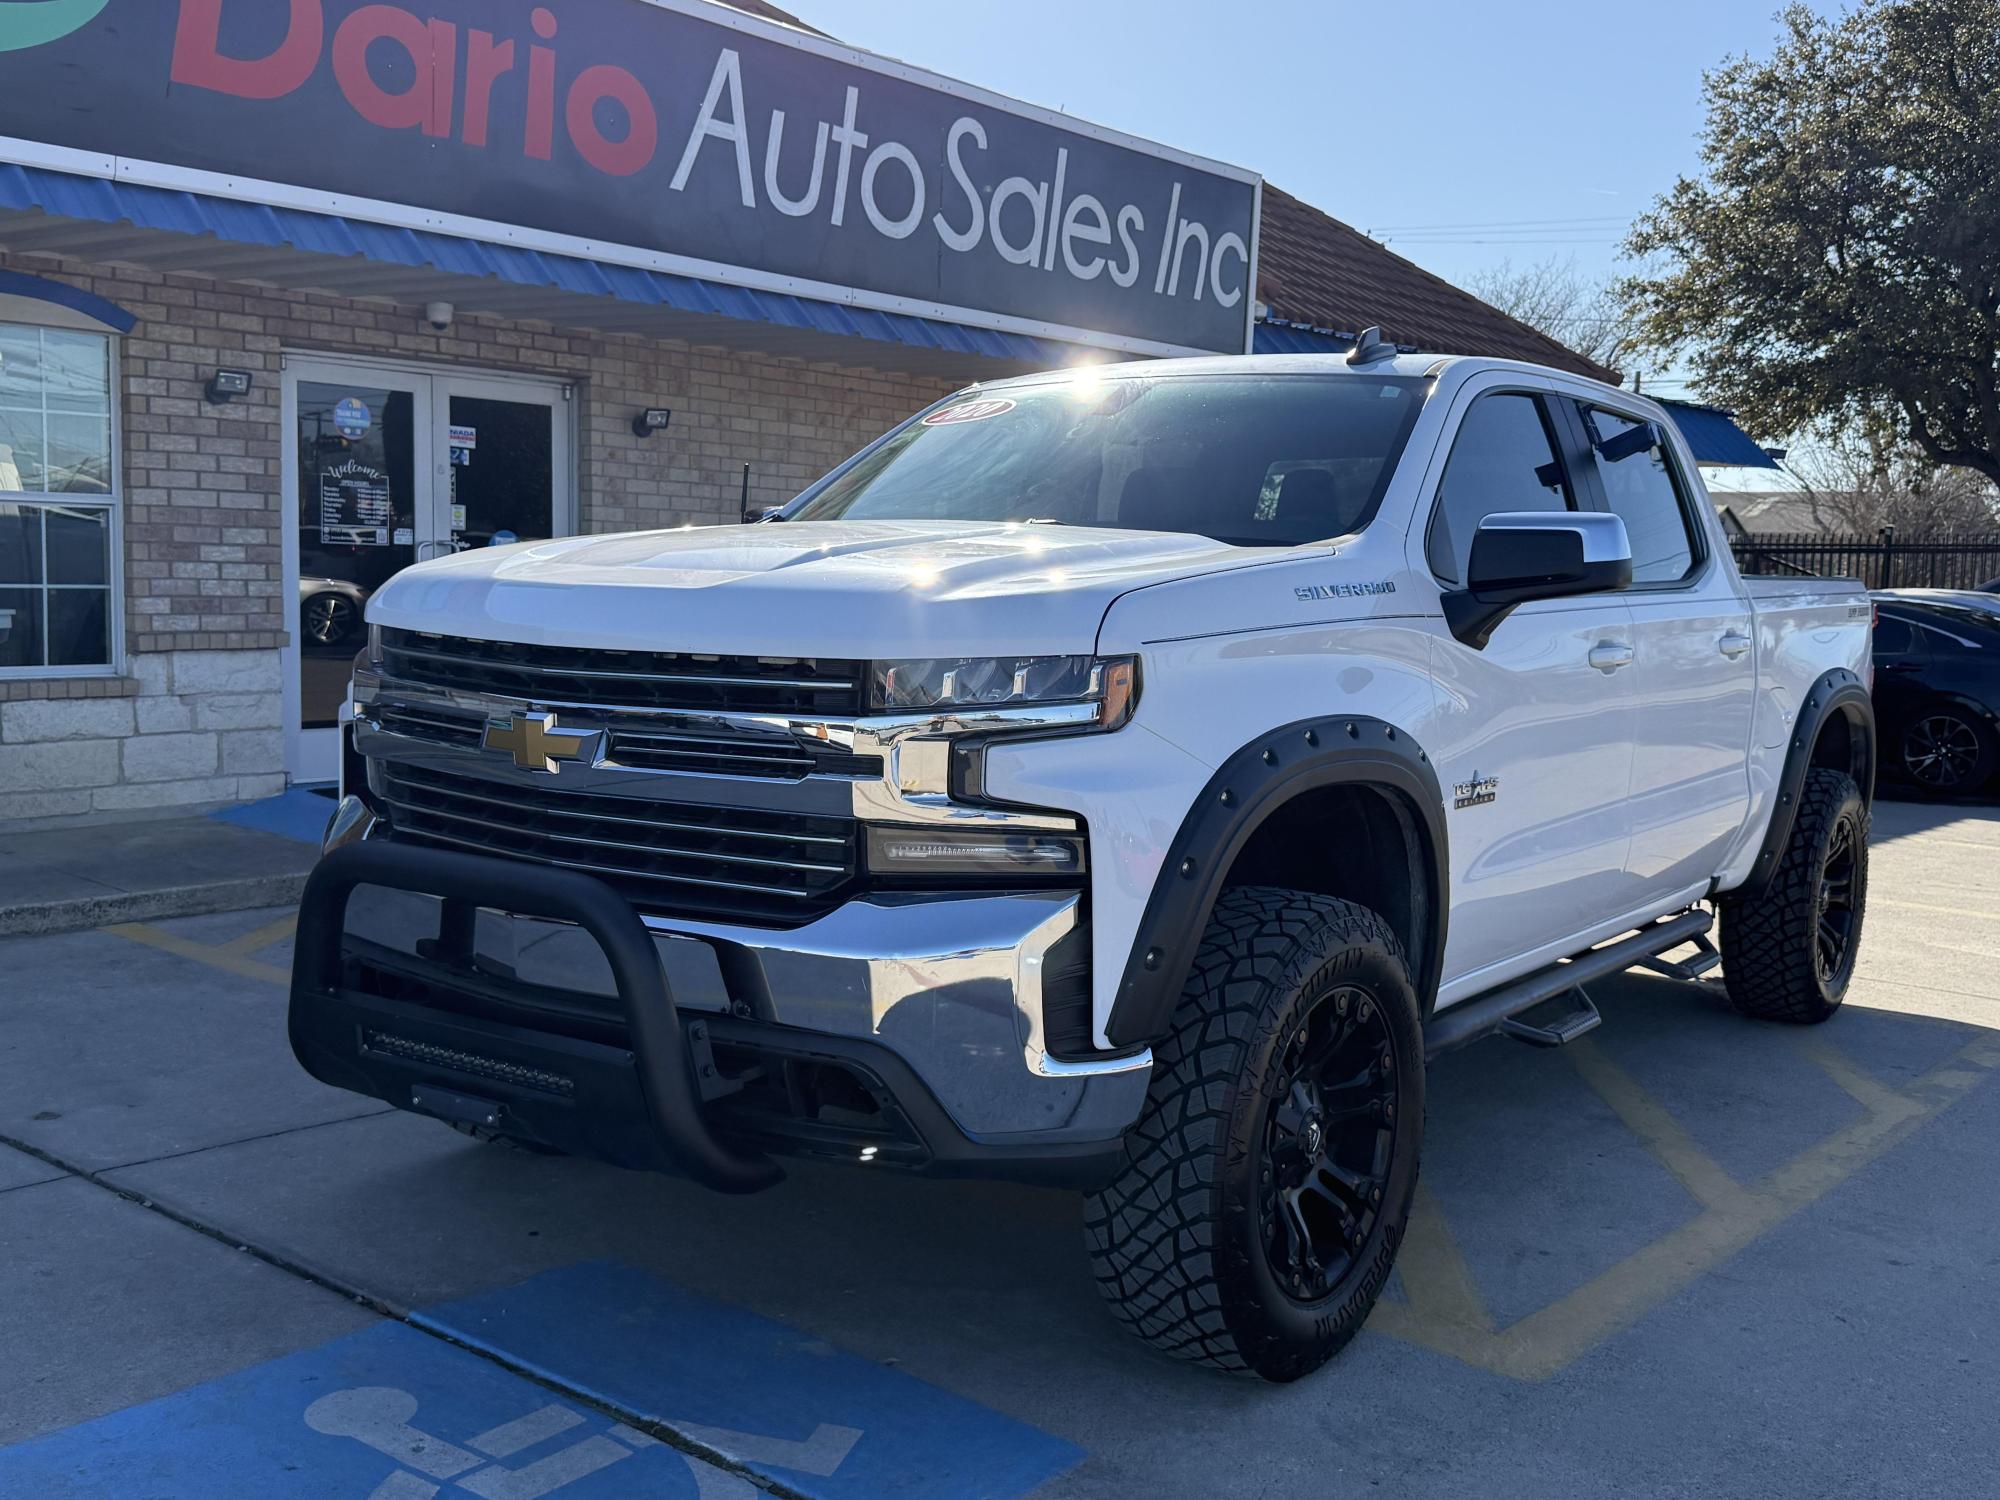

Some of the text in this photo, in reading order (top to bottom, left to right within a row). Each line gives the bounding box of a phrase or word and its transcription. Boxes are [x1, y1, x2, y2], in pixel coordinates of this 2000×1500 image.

[170, 0, 1248, 307] Dario Auto Sales Inc
[328, 459, 380, 479] Welcome
[1294, 581, 1396, 601] SILVERADO
